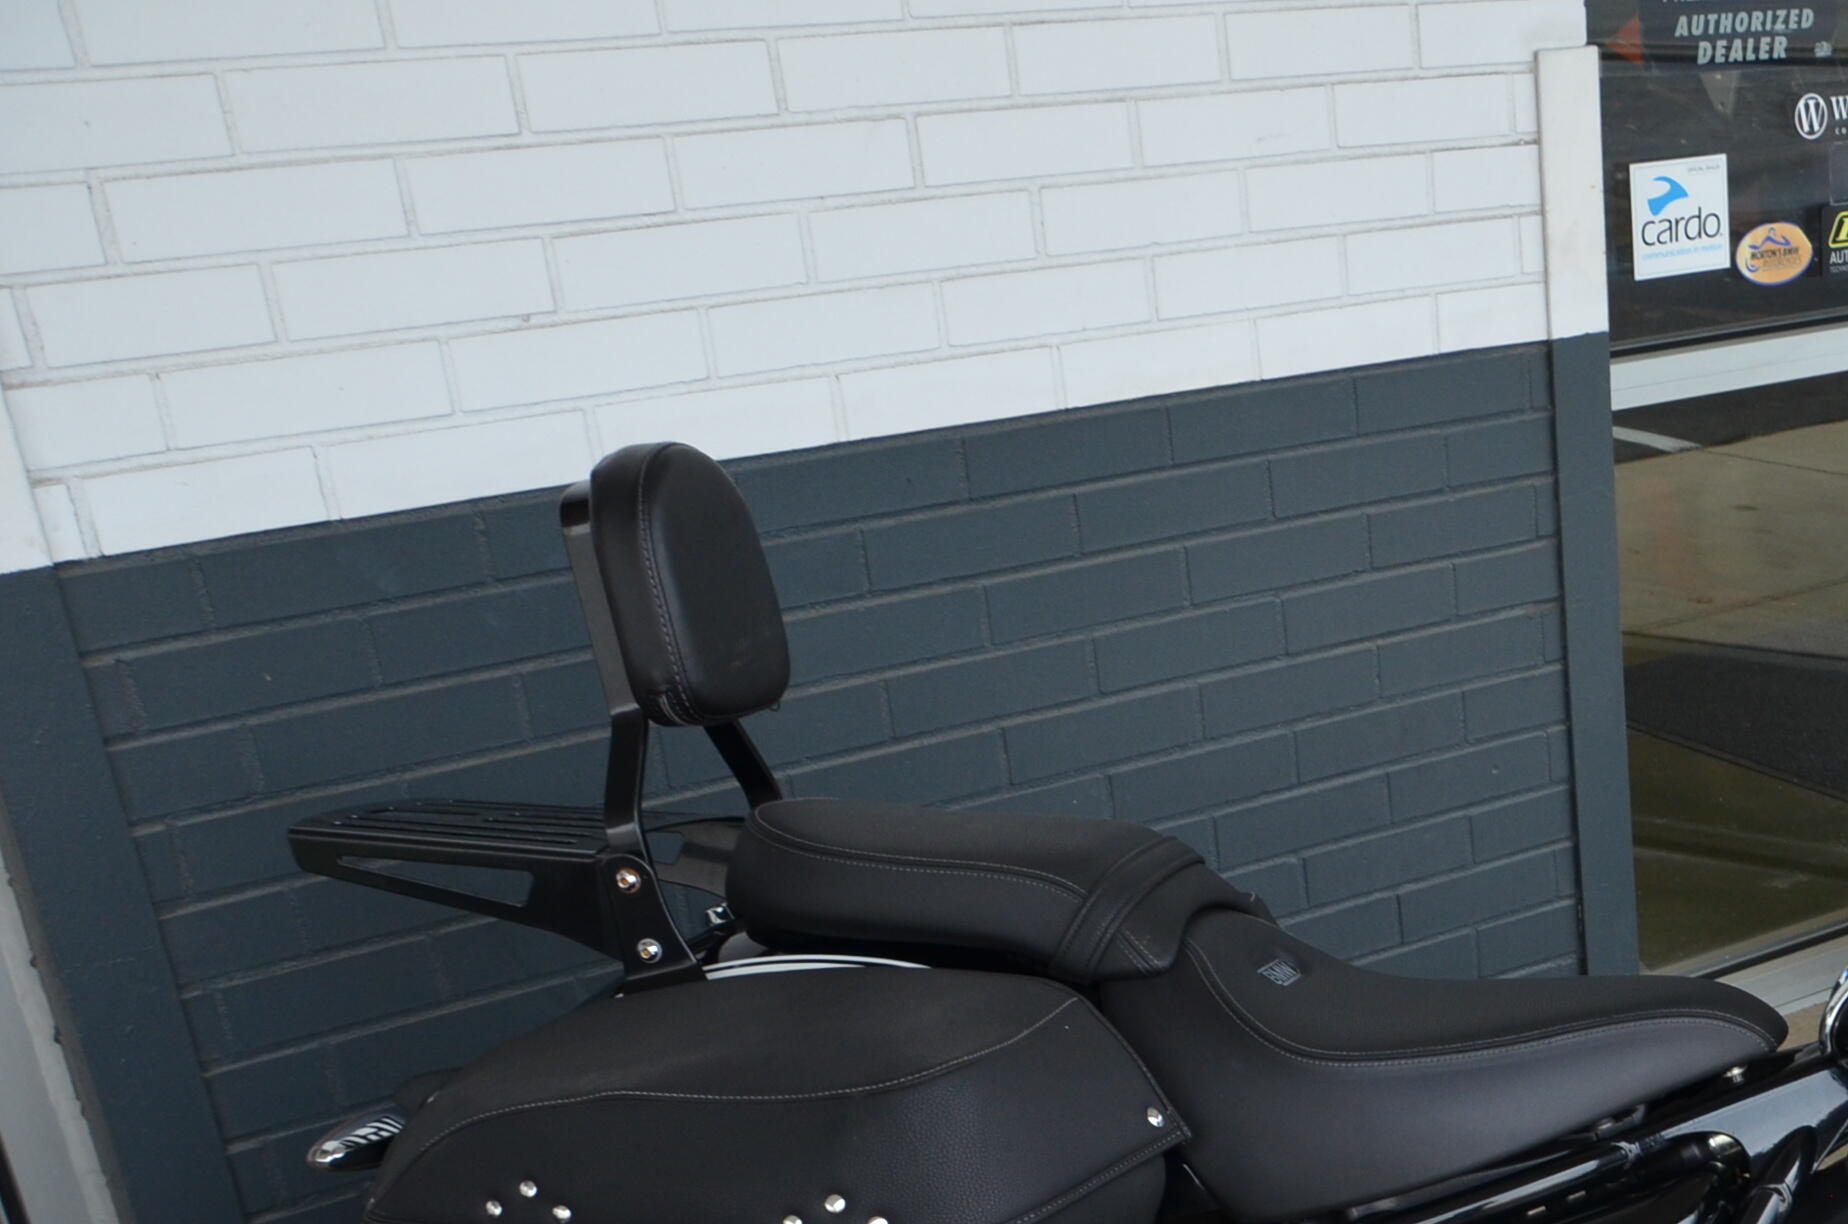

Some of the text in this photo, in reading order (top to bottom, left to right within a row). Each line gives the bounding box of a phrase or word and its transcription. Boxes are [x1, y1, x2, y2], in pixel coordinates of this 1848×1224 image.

[1674, 8, 1815, 37] AUTHORIZED
[1697, 36, 1788, 64] DEALER
[1641, 206, 1721, 246] cardo
